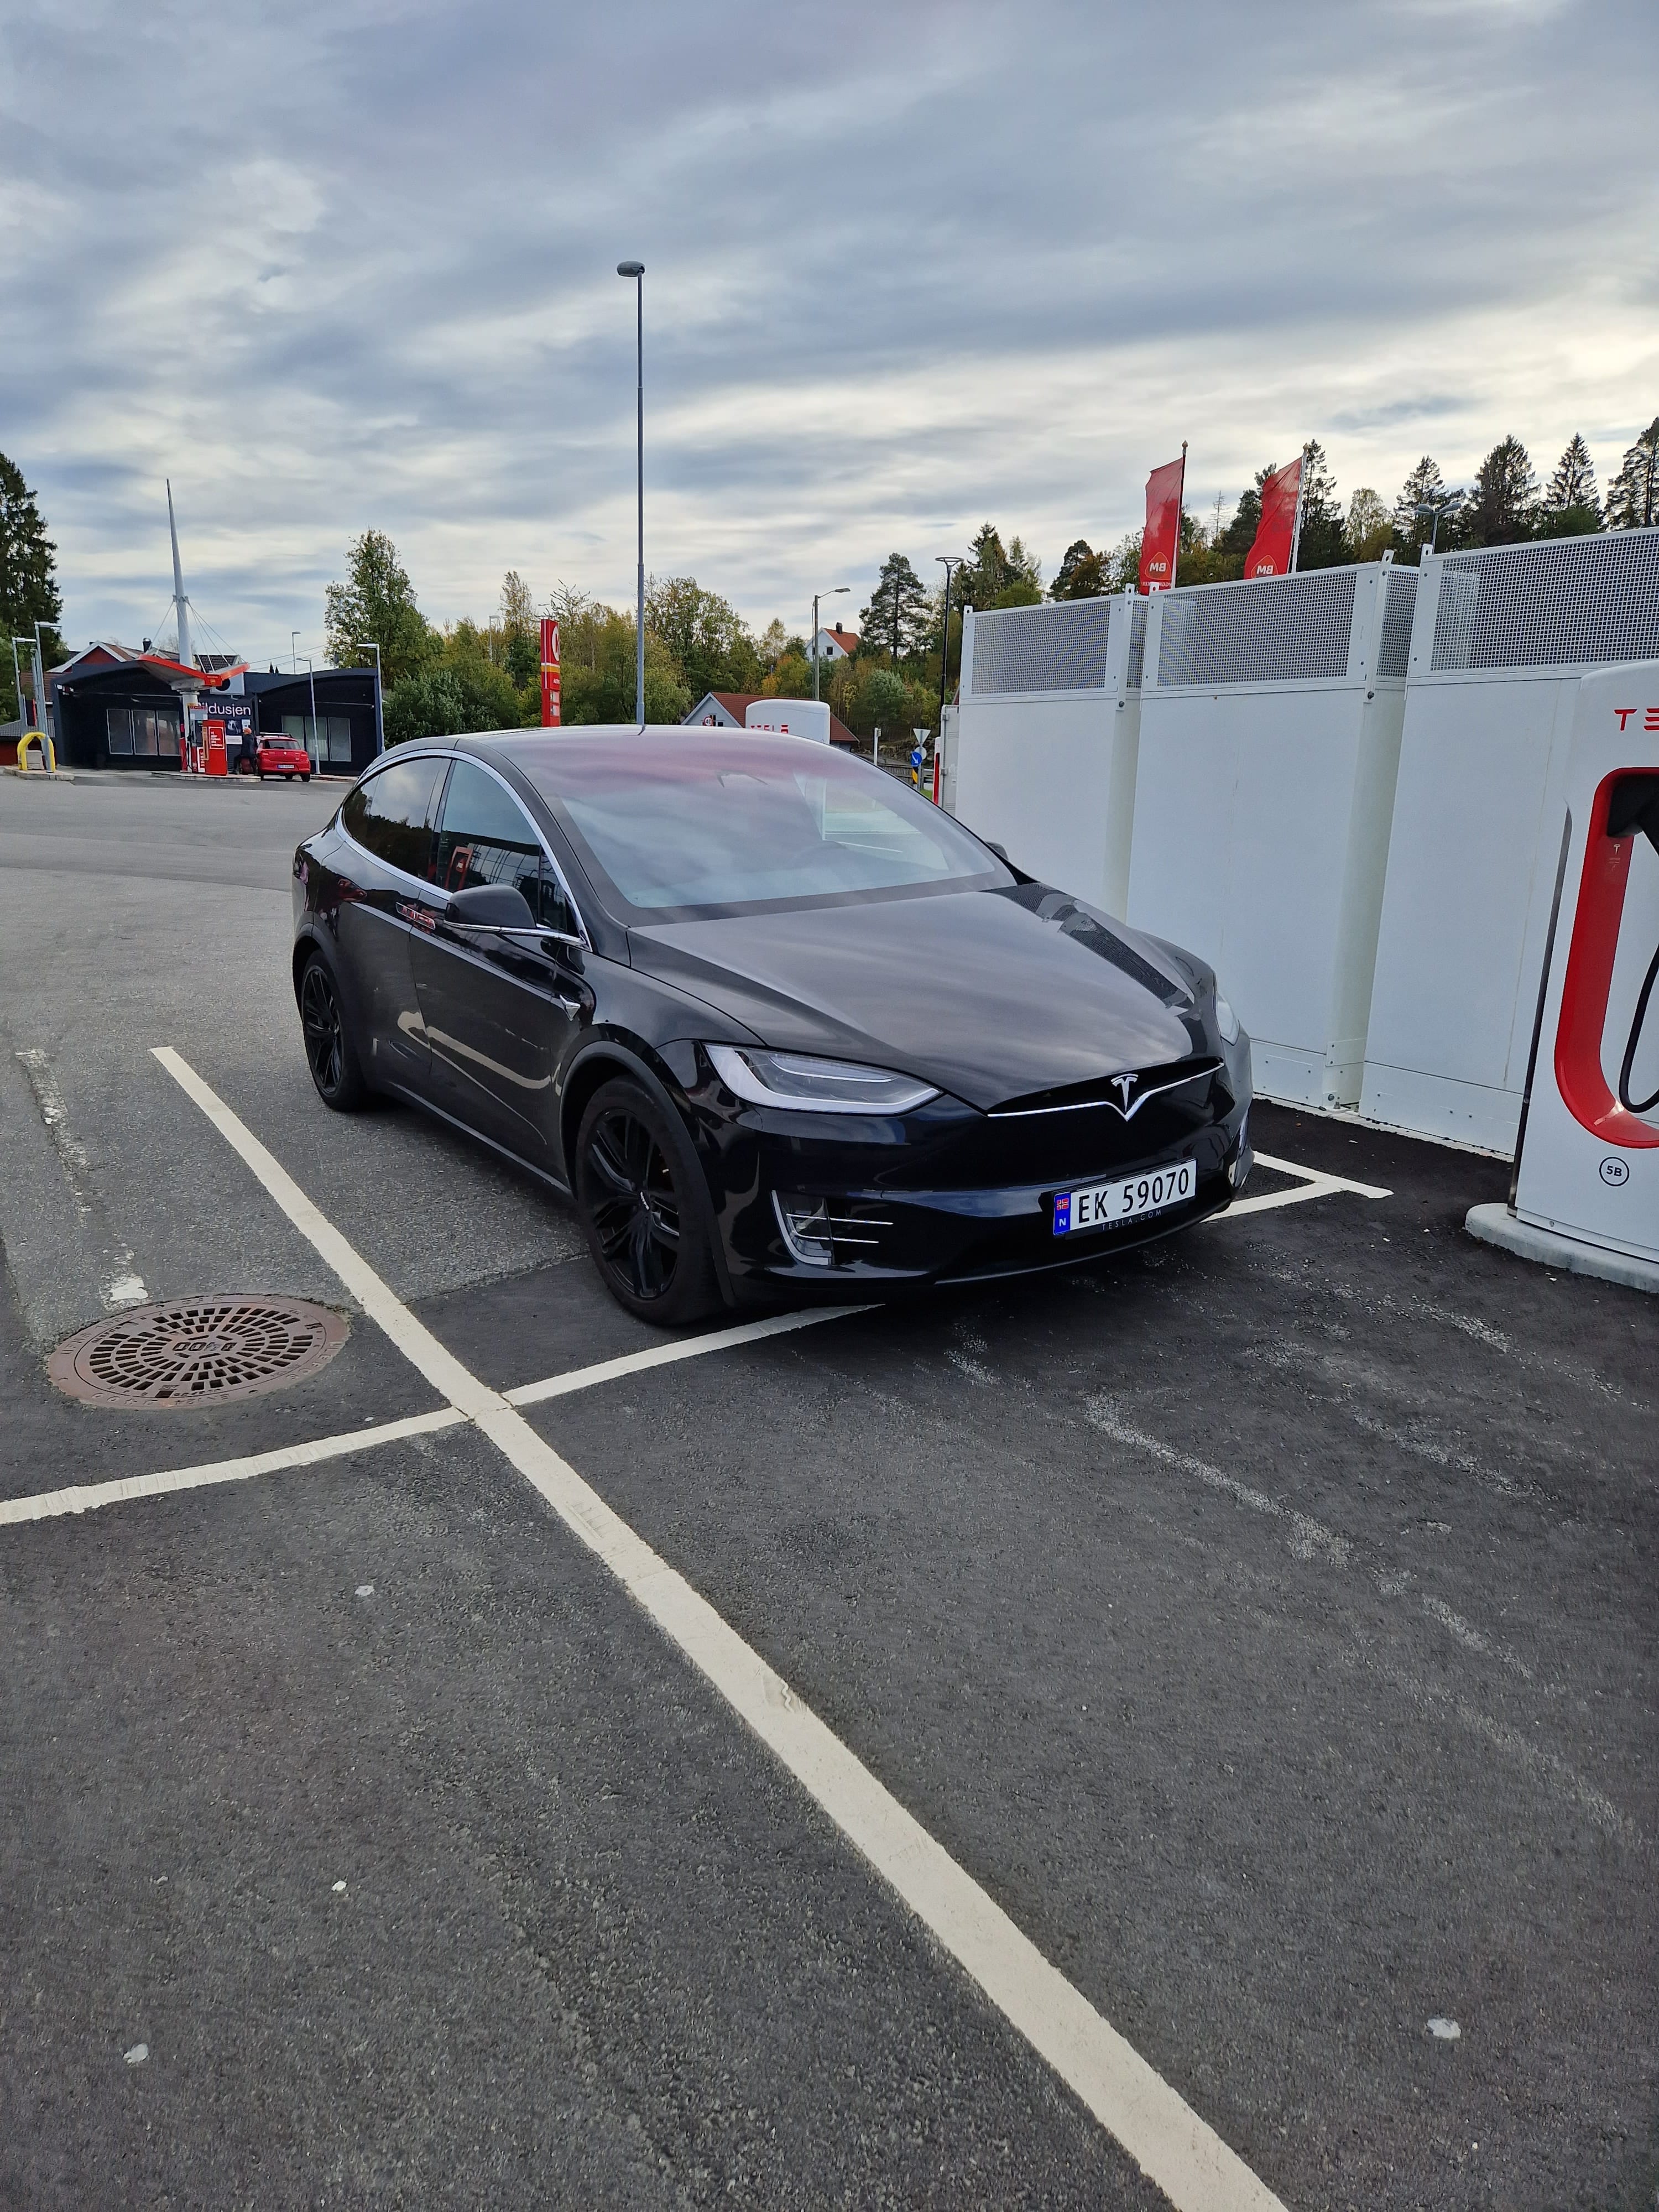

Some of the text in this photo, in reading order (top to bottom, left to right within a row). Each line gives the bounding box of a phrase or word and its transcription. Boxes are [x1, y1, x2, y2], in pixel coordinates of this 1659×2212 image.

[198, 702, 251, 717] ldusjen
[1606, 1165, 1622, 1177] 5B
[1079, 1168, 1189, 1223] EK 59070
[1059, 1217, 1066, 1227] N
[1102, 1209, 1161, 1230] TESLA.COM
